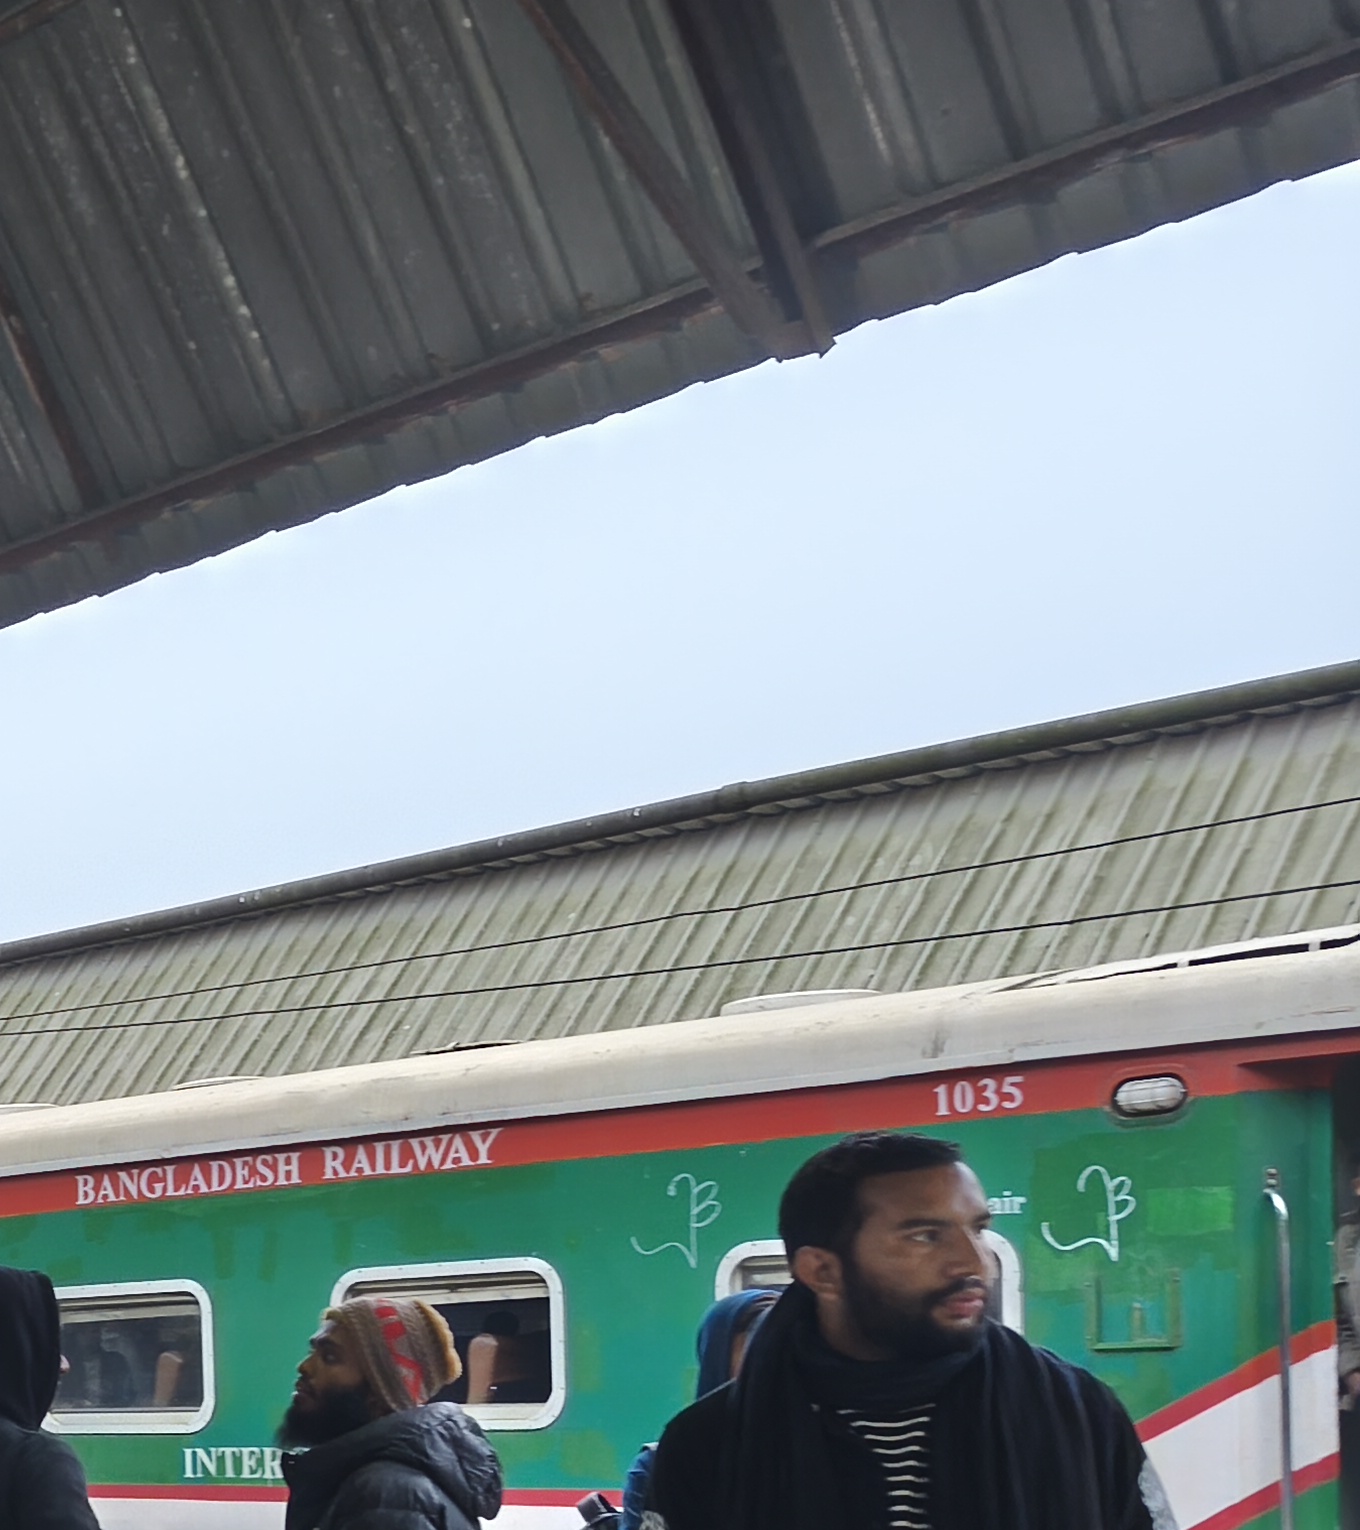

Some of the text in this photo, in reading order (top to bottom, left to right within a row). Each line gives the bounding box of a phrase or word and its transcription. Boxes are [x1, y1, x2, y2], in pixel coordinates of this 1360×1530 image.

[932, 1076, 1024, 1116] 1035
[75, 1128, 504, 1206] BANGLADESH RAILWAY
[182, 1446, 310, 1480] INTER
